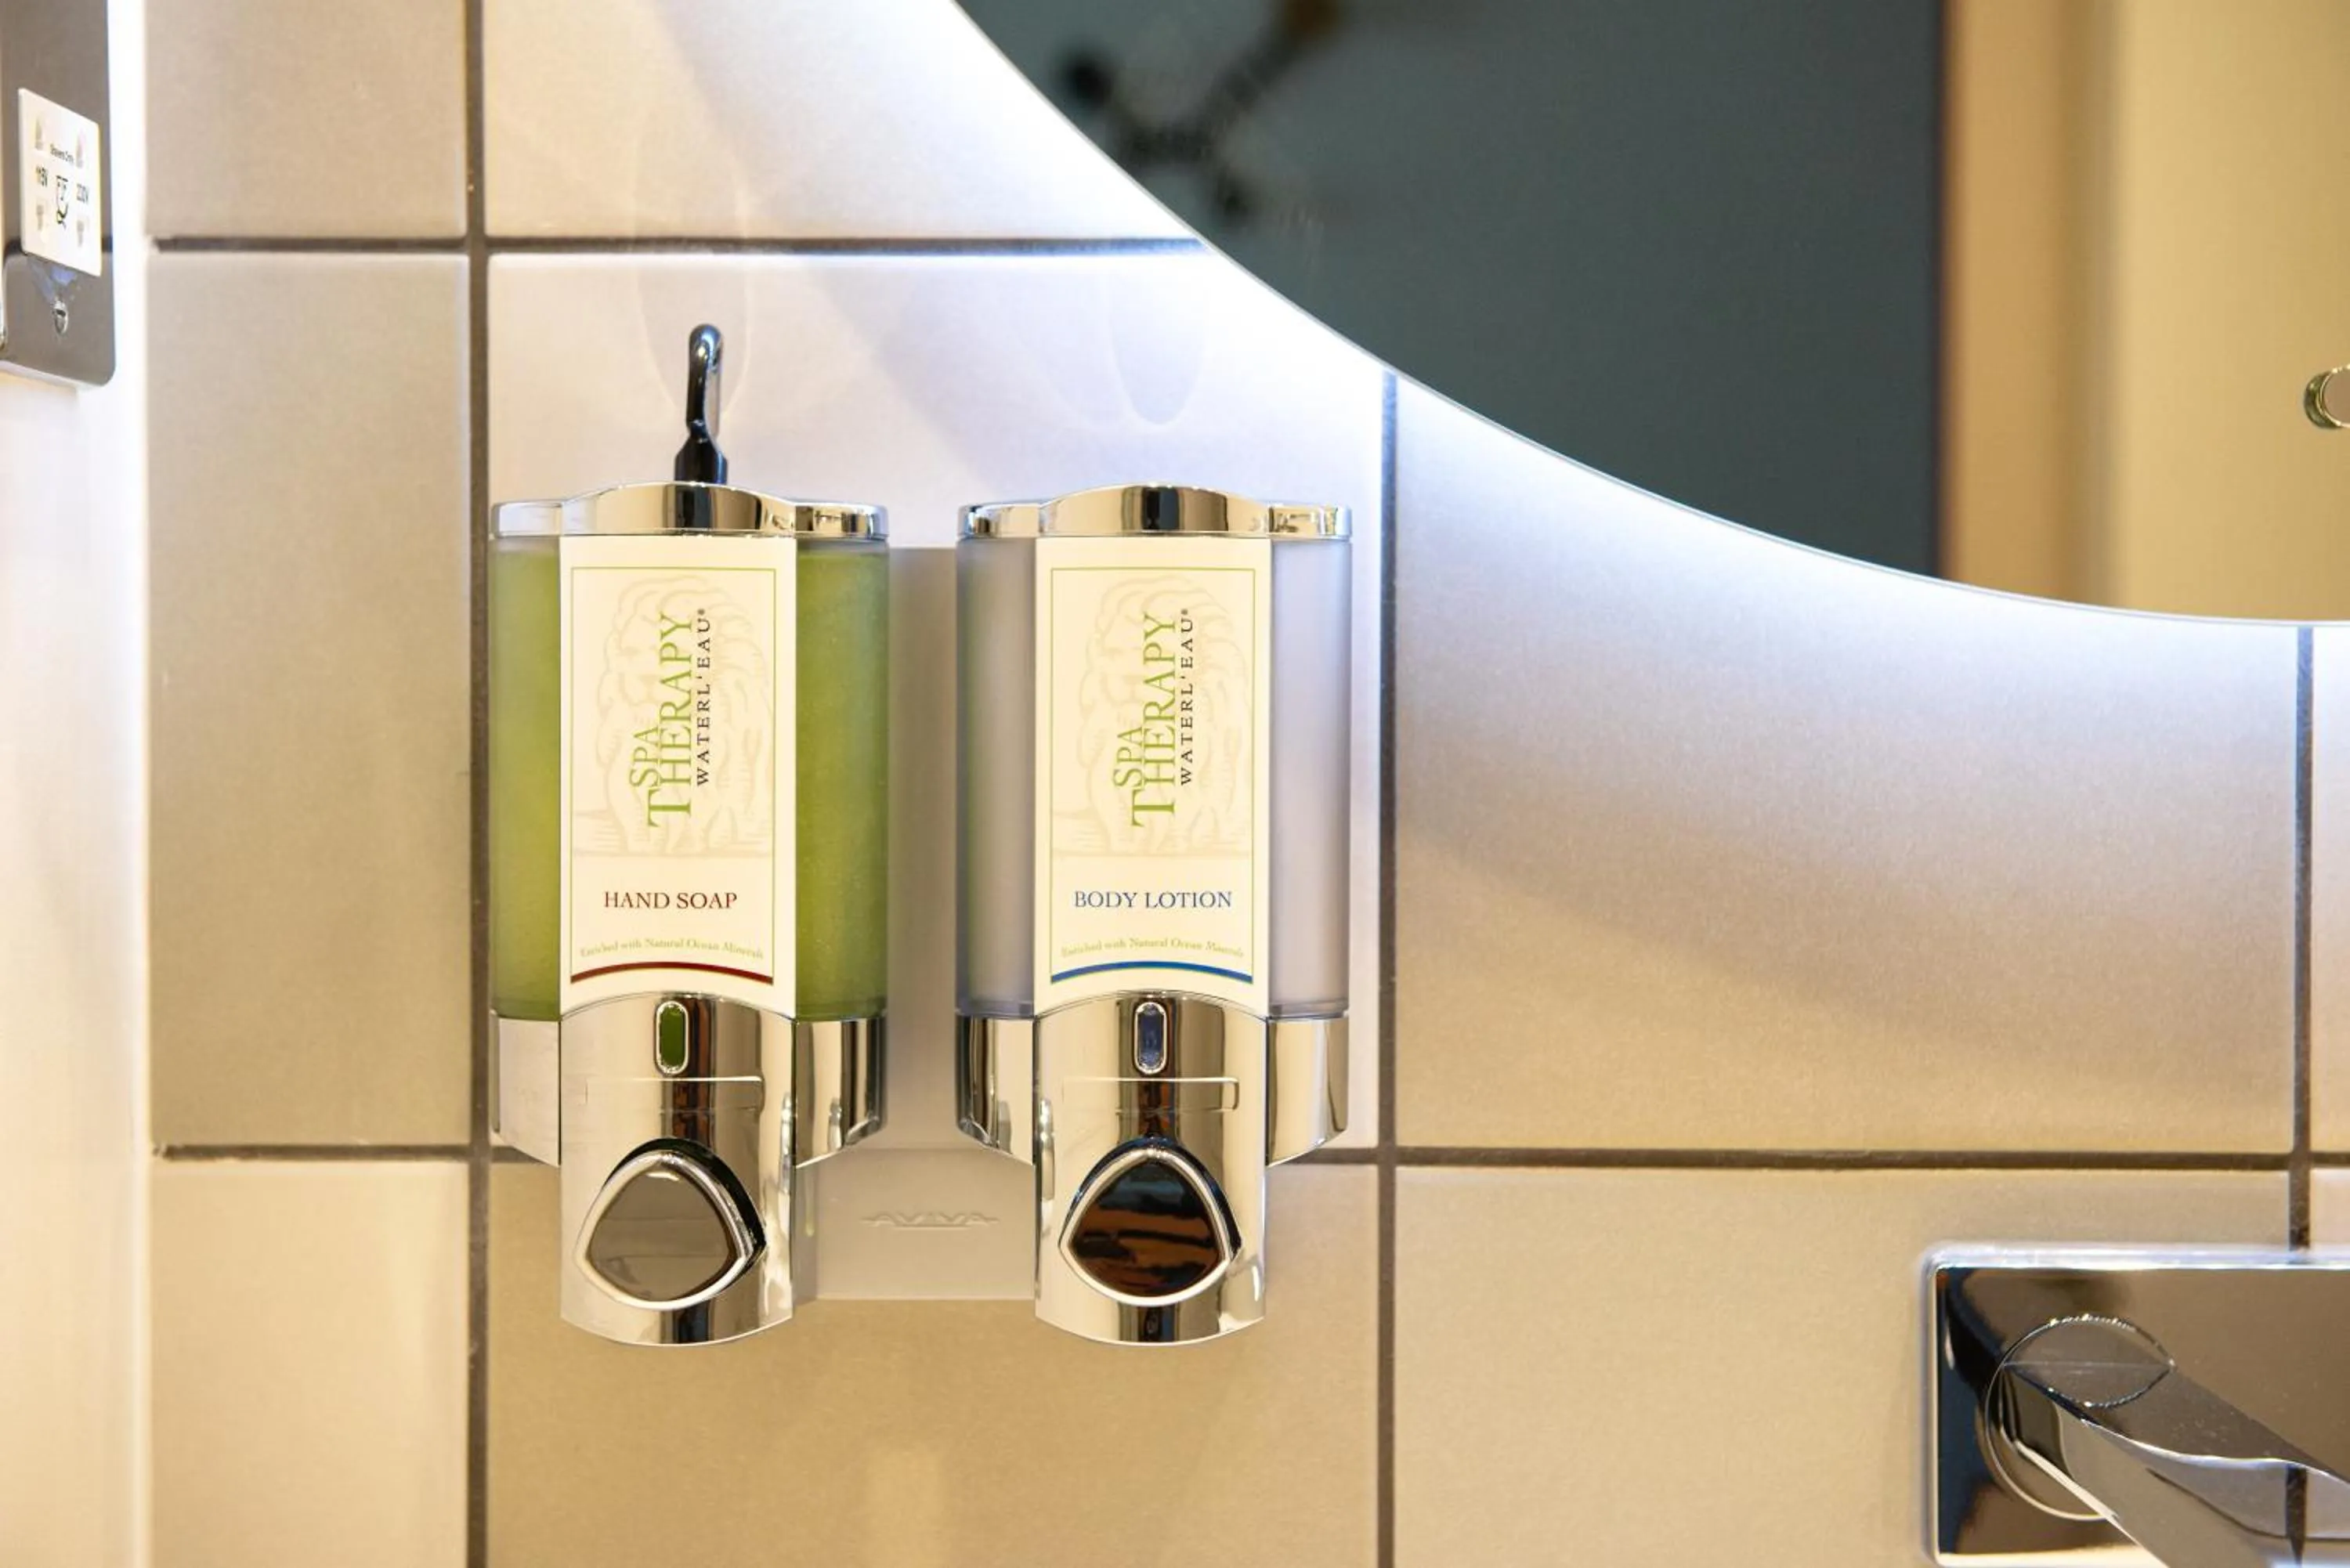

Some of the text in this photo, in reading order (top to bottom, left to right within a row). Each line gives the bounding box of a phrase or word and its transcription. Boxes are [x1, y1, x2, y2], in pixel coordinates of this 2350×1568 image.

[646, 612, 692, 828] THERAPY
[1130, 612, 1176, 828] THERAPY
[628, 725, 660, 788] SPA
[1112, 725, 1142, 788] SPA
[603, 891, 738, 909] HAND SOAP
[1074, 891, 1232, 909] BODY LOTION
[580, 938, 764, 959] Enriched with Natural Ocean Minerals
[1061, 941, 1102, 957] Enriched
[1104, 940, 1126, 950] with
[1129, 938, 1167, 948] Natural
[1170, 938, 1202, 950] Ocean
